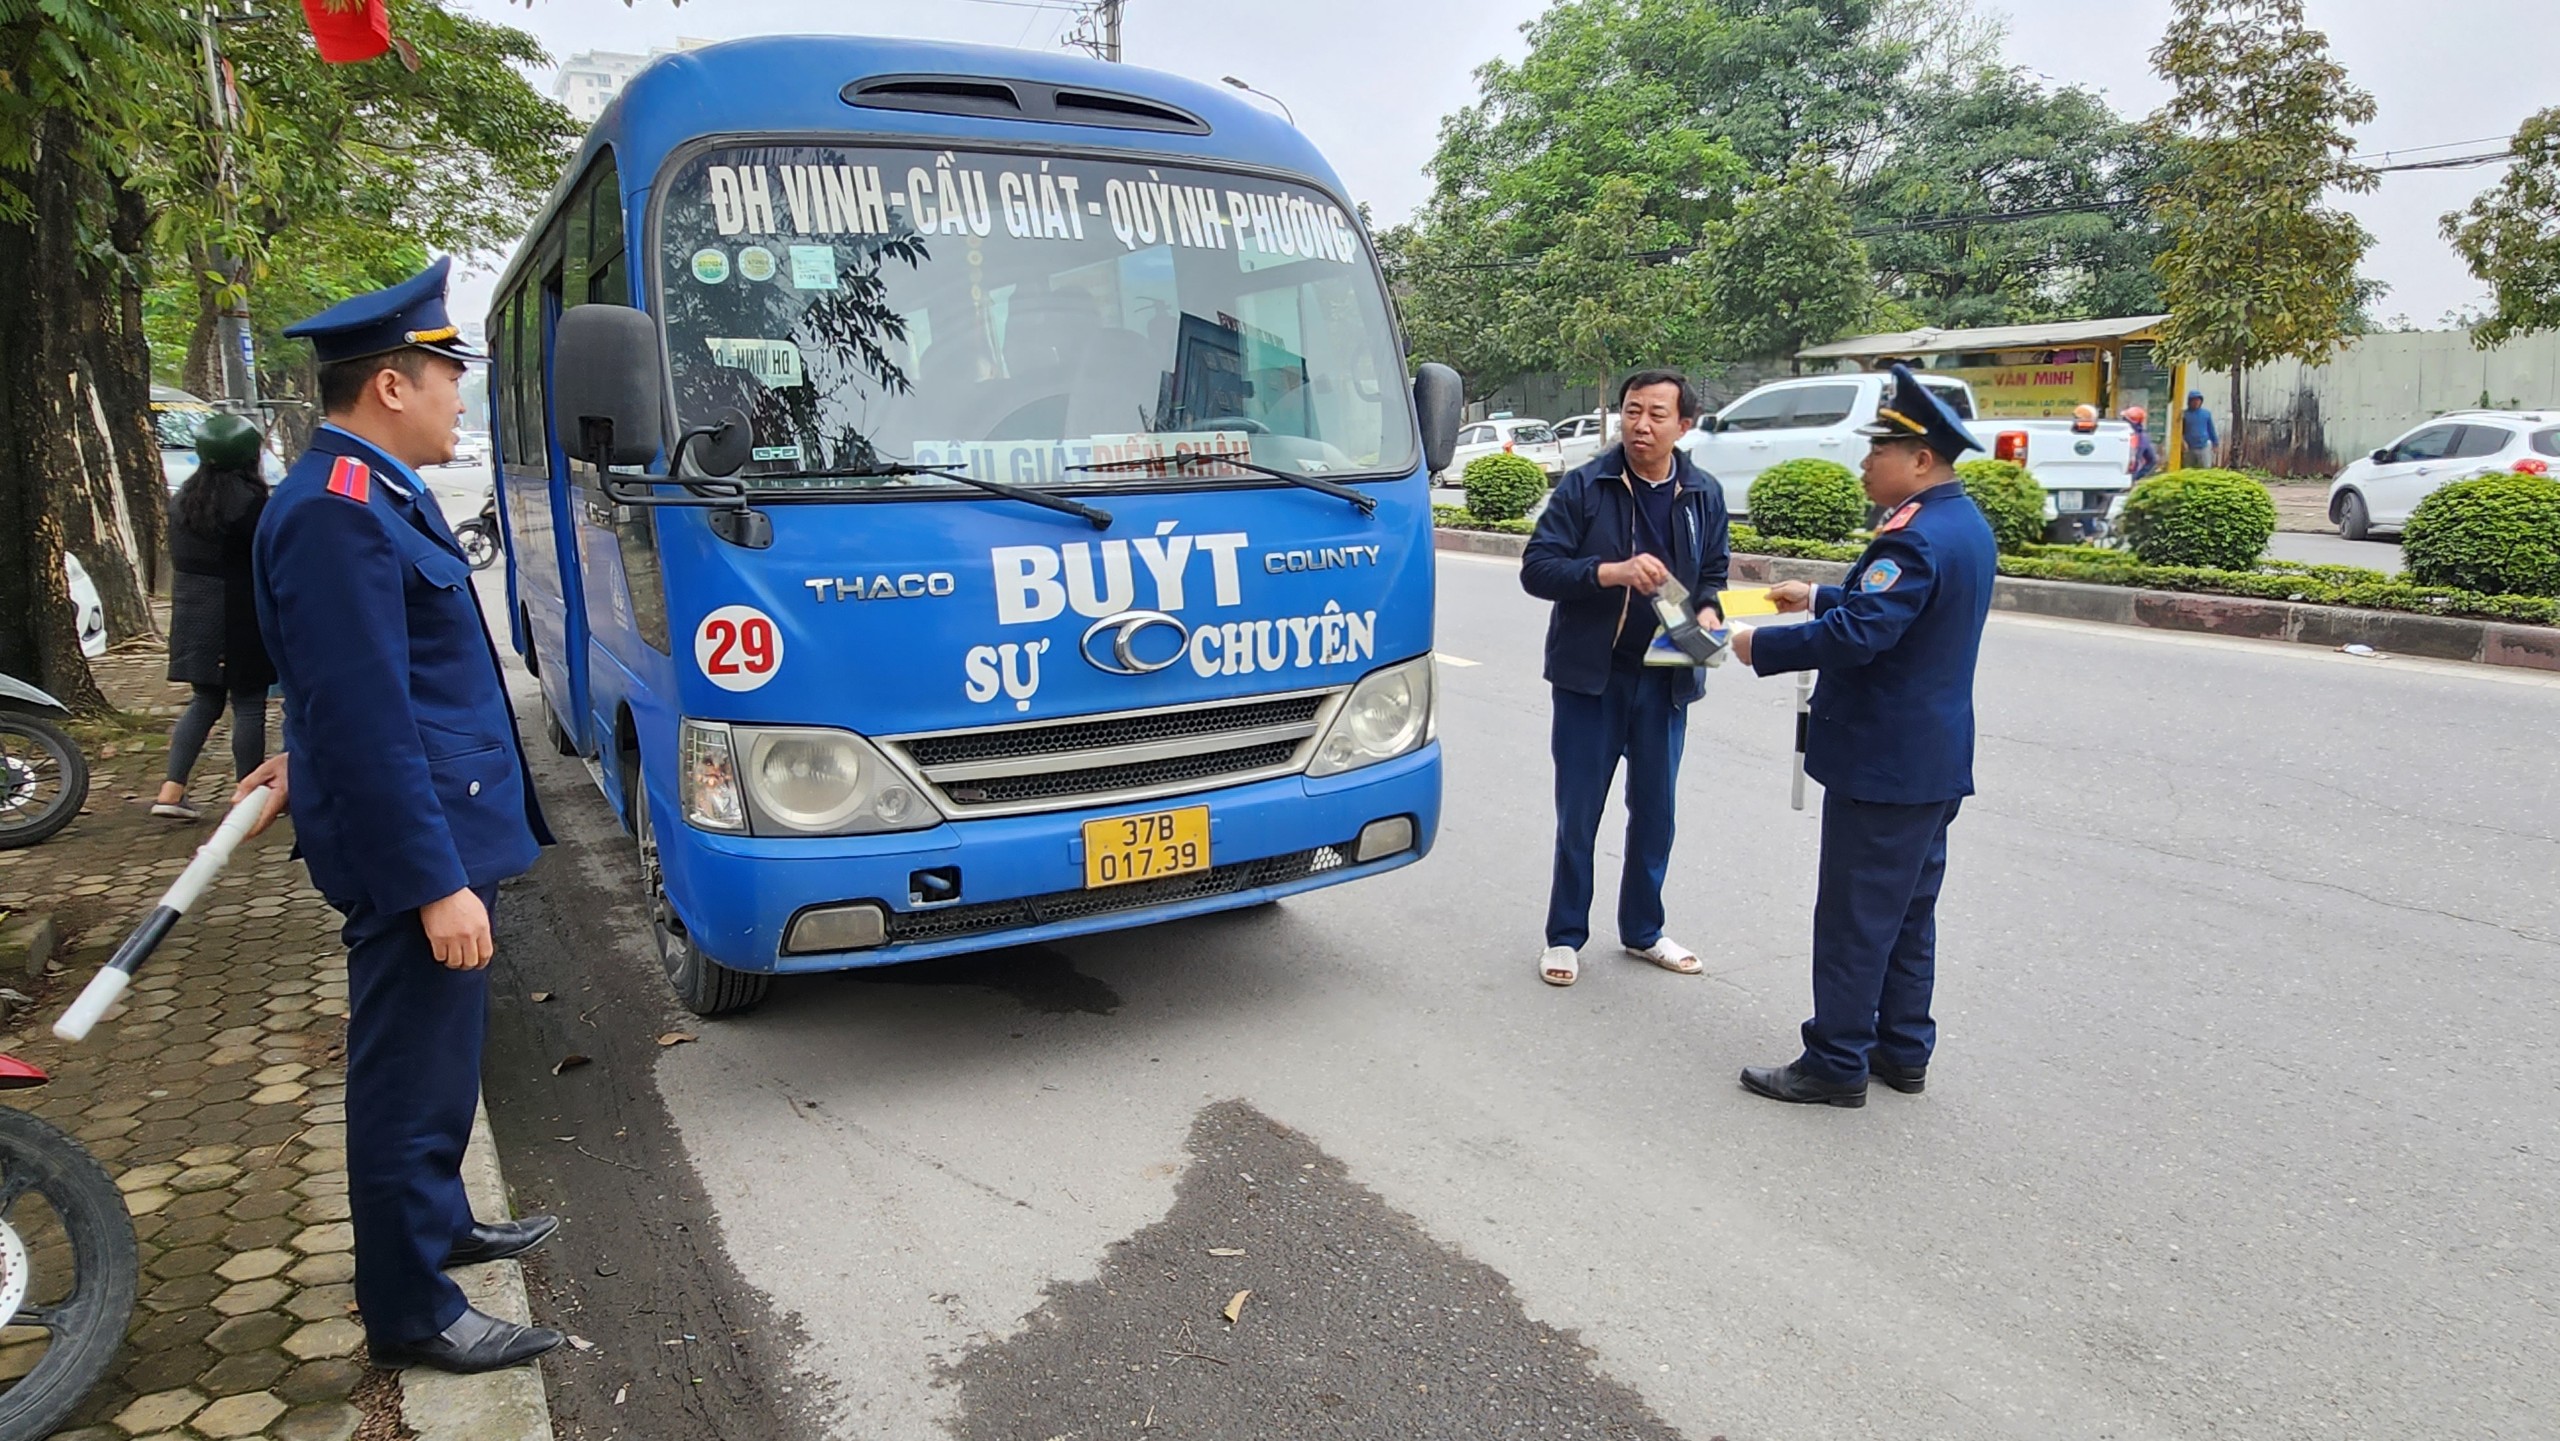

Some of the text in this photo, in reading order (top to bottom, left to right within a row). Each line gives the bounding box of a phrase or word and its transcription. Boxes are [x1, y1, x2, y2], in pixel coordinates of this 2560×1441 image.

[709, 165, 776, 235] ĐH
[780, 165, 888, 234] VINH
[907, 151, 991, 236] CẦU
[999, 161, 1084, 240] GIÁT
[1106, 170, 1226, 250] QUỲNH
[1226, 190, 1354, 264] PHƯƠNG
[2033, 370, 2074, 386] MINH
[991, 521, 1248, 625] BUÝT
[1265, 545, 1380, 574] COUNTY
[804, 572, 955, 602] THACO
[706, 618, 774, 675] 29
[965, 600, 1377, 711] SỰ CHUYÊN
[1122, 814, 1174, 846] 37B
[1101, 842, 1197, 881] 017.39
